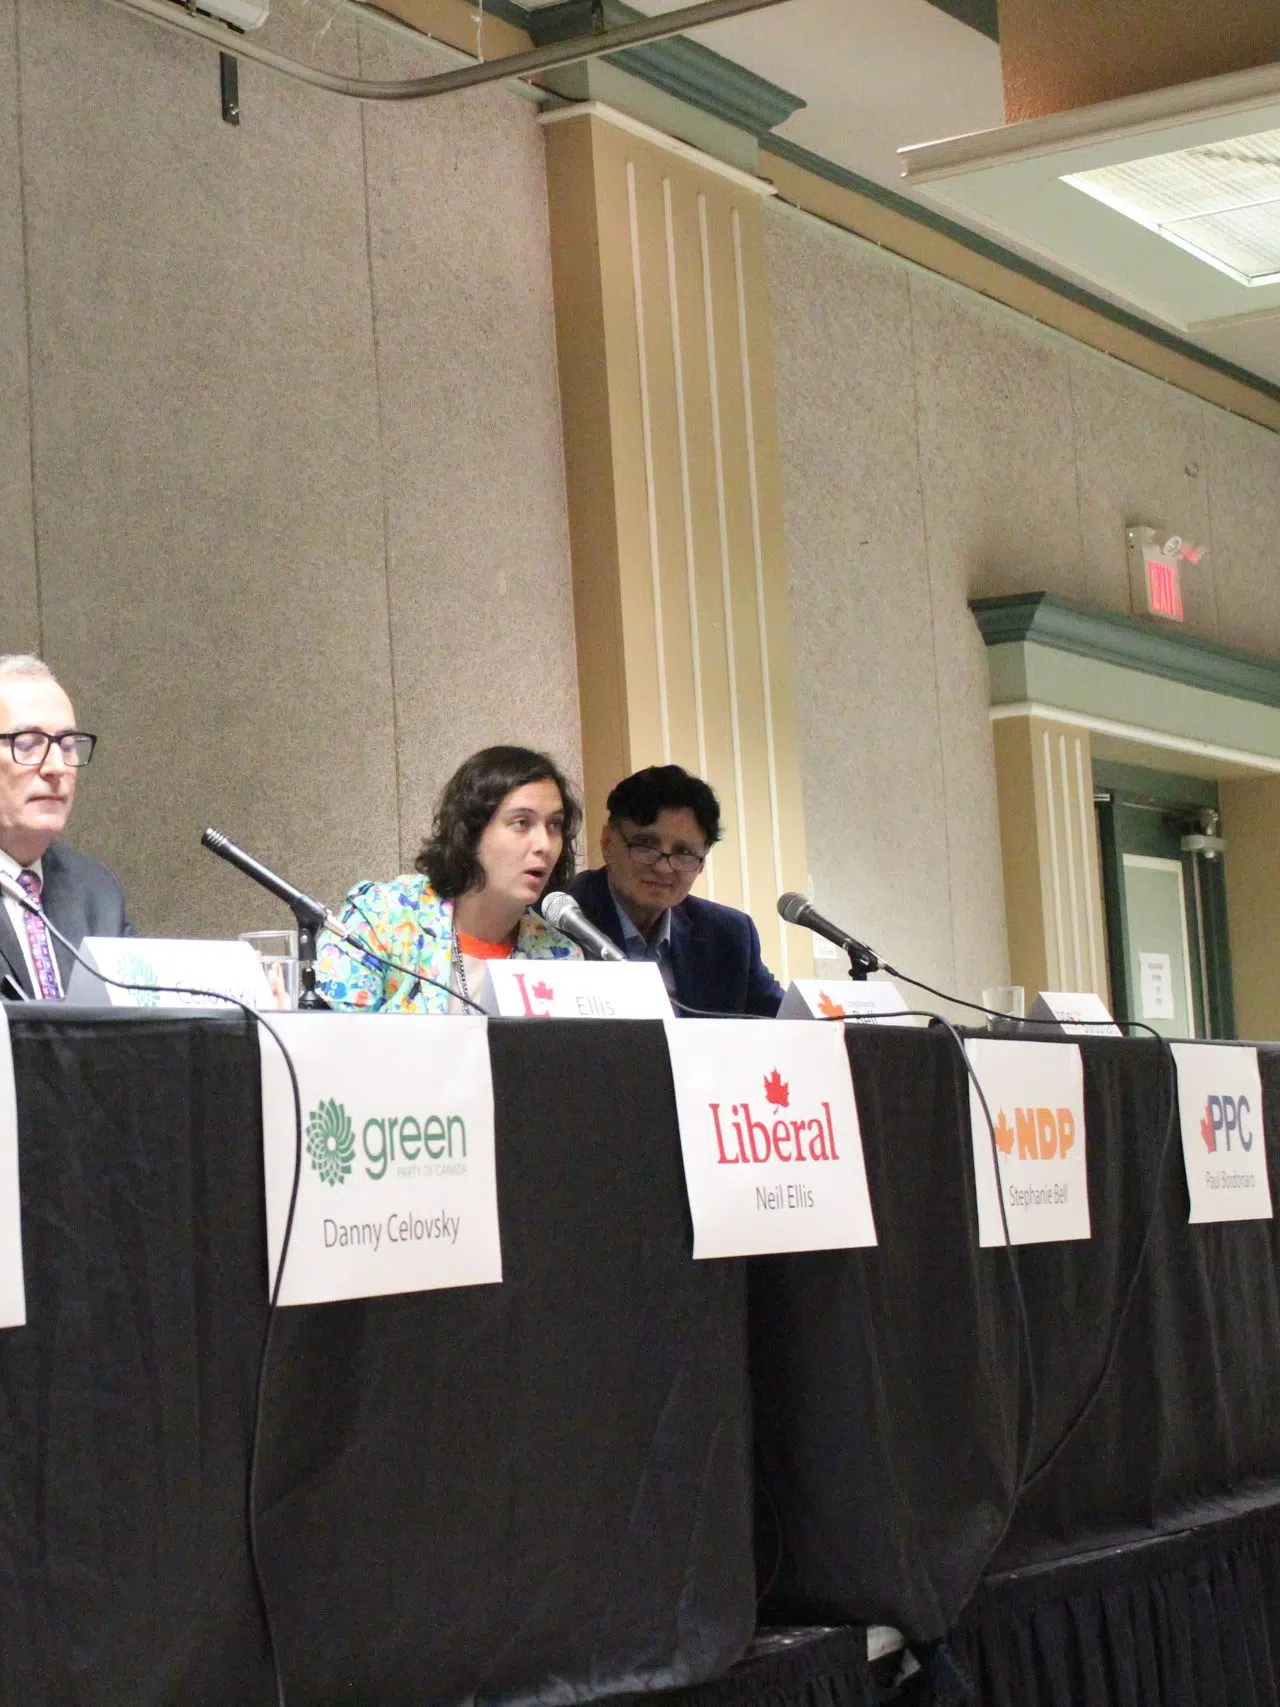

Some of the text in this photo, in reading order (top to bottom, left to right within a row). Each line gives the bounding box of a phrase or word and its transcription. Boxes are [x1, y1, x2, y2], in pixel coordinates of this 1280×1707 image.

[1148, 560, 1178, 616] EXIT
[576, 996, 616, 1016] Ellis
[362, 1115, 467, 1181] green
[708, 1102, 840, 1165] Liberal
[1014, 1107, 1076, 1161] NDP
[1208, 1095, 1253, 1152] PPC
[755, 1184, 815, 1210] Neil Ellis
[1009, 1183, 1069, 1210] Stephanie Bell
[323, 1209, 460, 1252] Danny Celovsky
